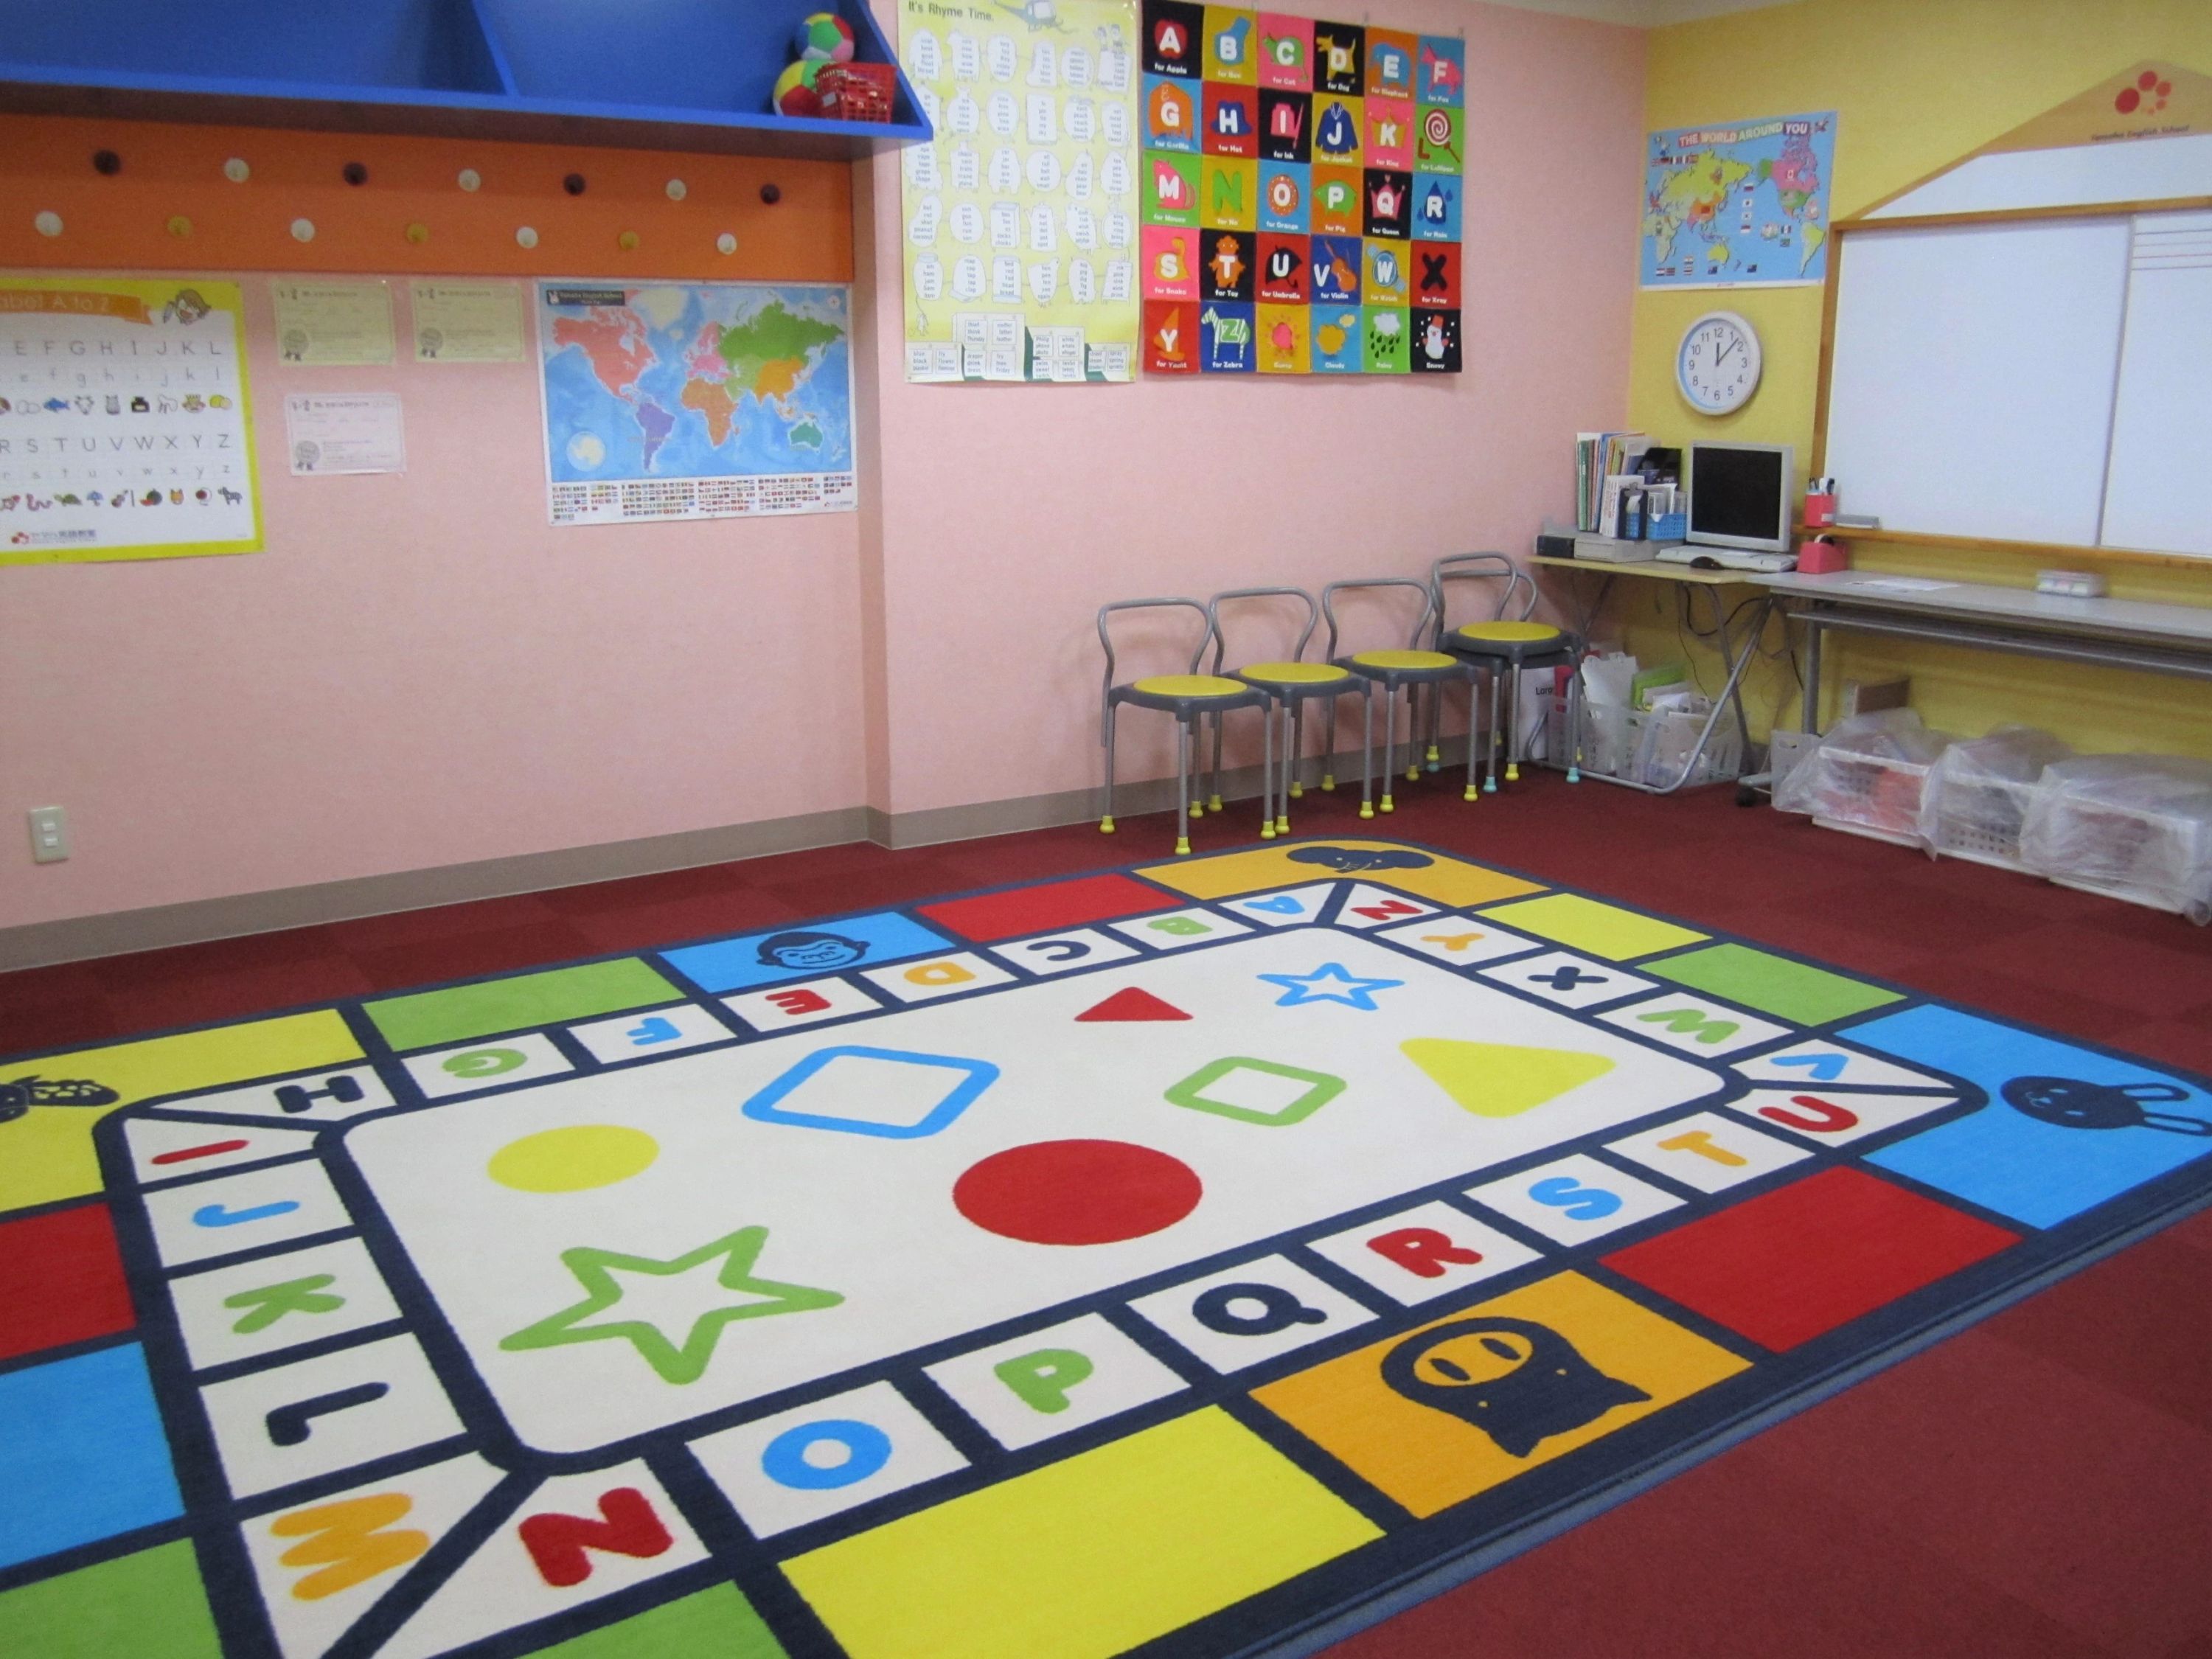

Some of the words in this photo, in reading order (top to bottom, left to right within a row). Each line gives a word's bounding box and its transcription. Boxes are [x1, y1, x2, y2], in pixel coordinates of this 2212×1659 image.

[908, 1, 923, 13] It's
[929, 3, 963, 19] Rhyme
[1159, 27, 1181, 54] A
[1220, 35, 1237, 61] B
[1276, 41, 1295, 66] C
[1330, 46, 1347, 71] D
[1383, 55, 1399, 78] E
[1433, 60, 1448, 83] F
[1161, 102, 1180, 127] G
[1219, 108, 1238, 133] H
[1280, 110, 1287, 134] I
[1327, 122, 1343, 146] J
[1380, 122, 1397, 147] K
[1679, 133, 1699, 147] THE
[1700, 131, 1736, 145] WORLD
[1738, 122, 1783, 141] AROUND
[1785, 122, 1808, 135] YOU
[1417, 137, 1430, 160] L
[1159, 174, 1180, 201] M
[1212, 170, 1242, 213] N
[1273, 184, 1291, 206] O
[1328, 186, 1344, 209] P
[1377, 192, 1394, 216] Q
[1427, 195, 1443, 218] R
[1161, 253, 1178, 279] S
[1219, 254, 1236, 279] T
[1273, 254, 1290, 277] U
[1313, 263, 1330, 288] V
[1377, 260, 1394, 283] W
[1420, 252, 1447, 291] X
[1160, 329, 1178, 353] Y
[1701, 332, 1709, 342] 11
[1714, 327, 1723, 338] 12
[15, 341, 27, 355] E
[44, 341, 55, 355] F
[70, 341, 86, 355] G
[100, 341, 113, 355] H
[133, 341, 136, 355] I
[156, 341, 167, 355] J
[183, 341, 195, 355] K
[210, 341, 221, 355] L
[1691, 344, 1701, 355] 10
[1737, 341, 1744, 352] 2
[1688, 360, 1694, 370] 9
[1741, 358, 1747, 368] 3
[76, 374, 86, 388] g
[103, 369, 114, 380] h
[186, 368, 195, 380] k
[216, 367, 219, 380] l
[1693, 375, 1698, 386] 8
[1737, 375, 1743, 383] 4
[1703, 386, 1708, 396] 7
[1714, 390, 1720, 400] 6
[1728, 386, 1733, 396] 5
[27, 439, 38, 453] S
[55, 438, 68, 451] T
[83, 439, 96, 451] U
[111, 438, 124, 451] V
[136, 437, 154, 450] W
[165, 437, 177, 449] X
[193, 435, 202, 448] Y
[219, 434, 230, 448] Z
[1243, 896, 1306, 916] A
[1350, 900, 1424, 921] Z
[1147, 916, 1213, 936] B
[1026, 940, 1091, 962] C
[1419, 933, 1485, 950] Y
[903, 961, 976, 986] D
[1527, 966, 1609, 990] X
[764, 990, 832, 1016] E
[627, 1017, 682, 1046] F
[1635, 1009, 1740, 1044] W
[442, 1048, 527, 1078] G
[1770, 1053, 1849, 1081] V
[274, 1074, 364, 1114] H
[1758, 1096, 1859, 1132] U
[151, 1139, 250, 1165] I
[1656, 1130, 1747, 1167] T
[1528, 1177, 1623, 1221] S
[192, 1200, 300, 1228] J
[1366, 1227, 1483, 1279] R
[223, 1274, 346, 1335] K
[1192, 1281, 1328, 1336] Q
[994, 1348, 1094, 1415] P
[265, 1381, 389, 1447] L
[761, 1418, 891, 1491] O
[270, 1492, 431, 1601] M
[518, 1487, 674, 1587] N
